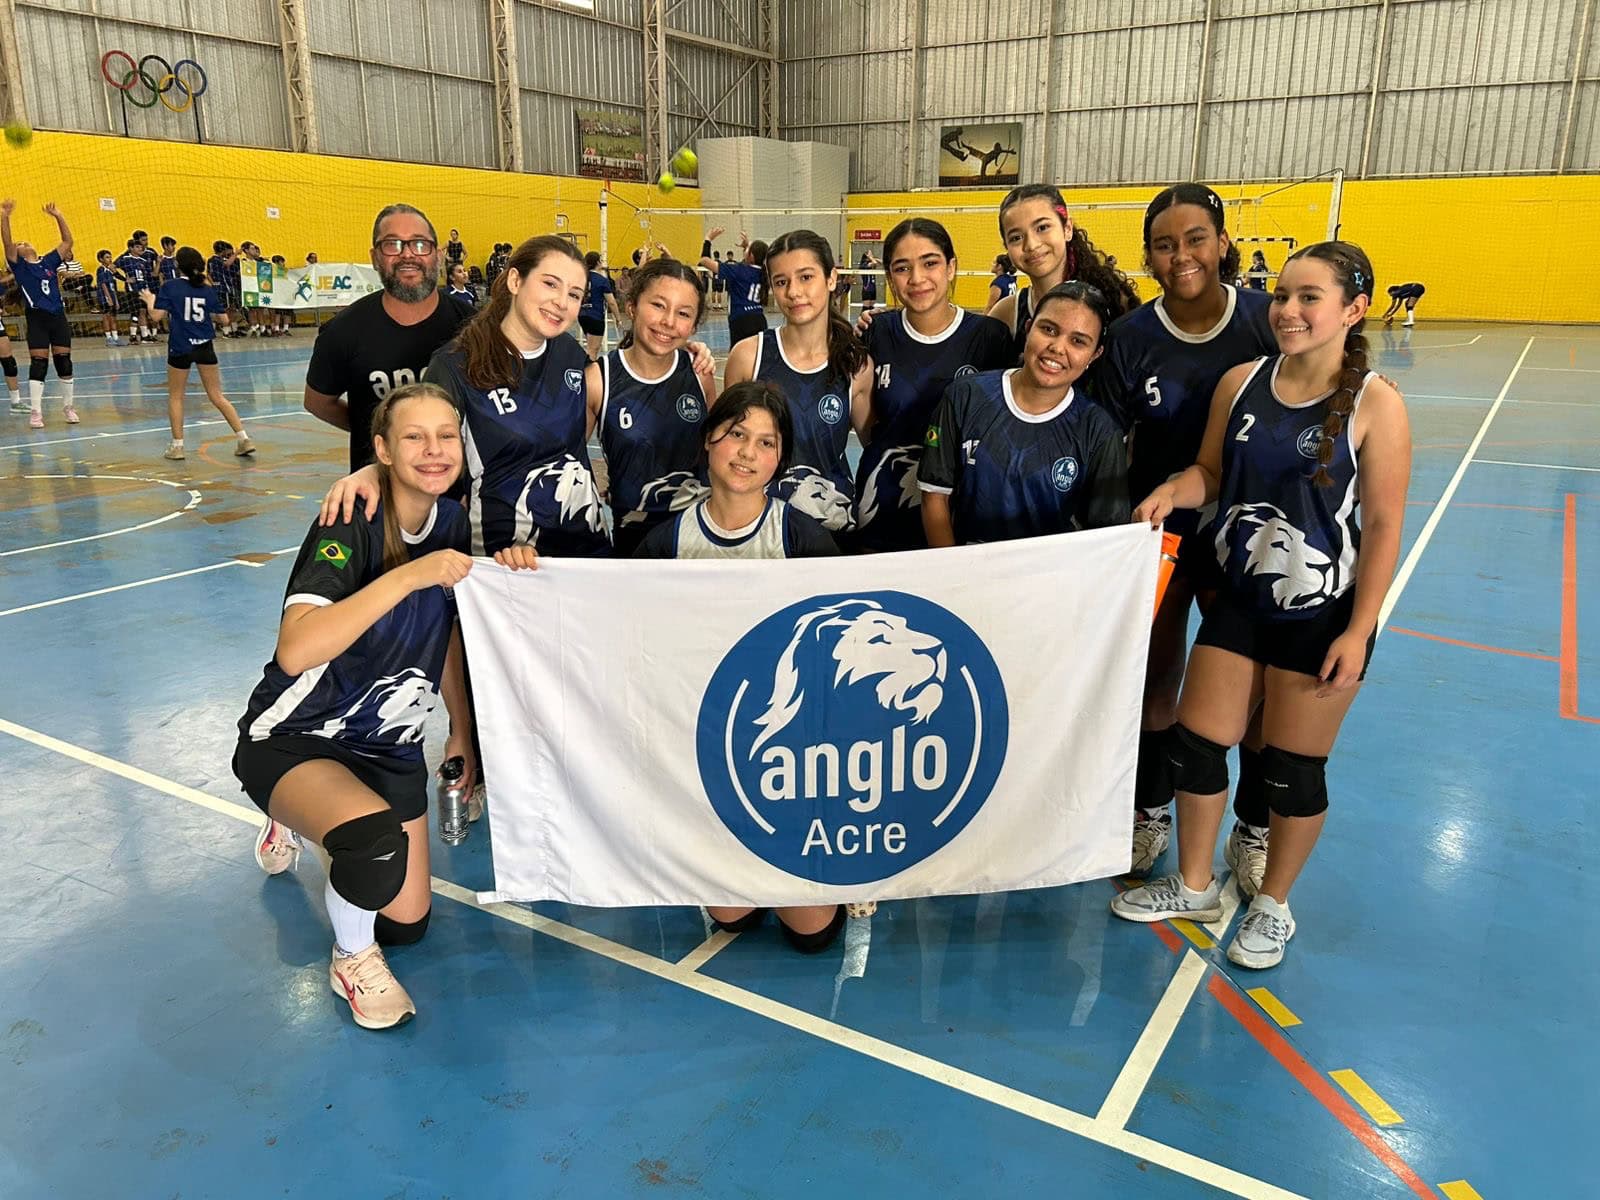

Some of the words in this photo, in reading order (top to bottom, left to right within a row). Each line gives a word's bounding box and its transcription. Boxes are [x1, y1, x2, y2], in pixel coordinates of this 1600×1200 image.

[316, 275, 352, 290] JEAC
[184, 296, 206, 322] 15
[875, 363, 891, 389] 14
[487, 387, 518, 415] 13
[1144, 376, 1162, 406] 5
[618, 406, 633, 430] 6
[1235, 413, 1256, 442] 2
[759, 724, 948, 813] anglo
[801, 818, 907, 856] Acre
